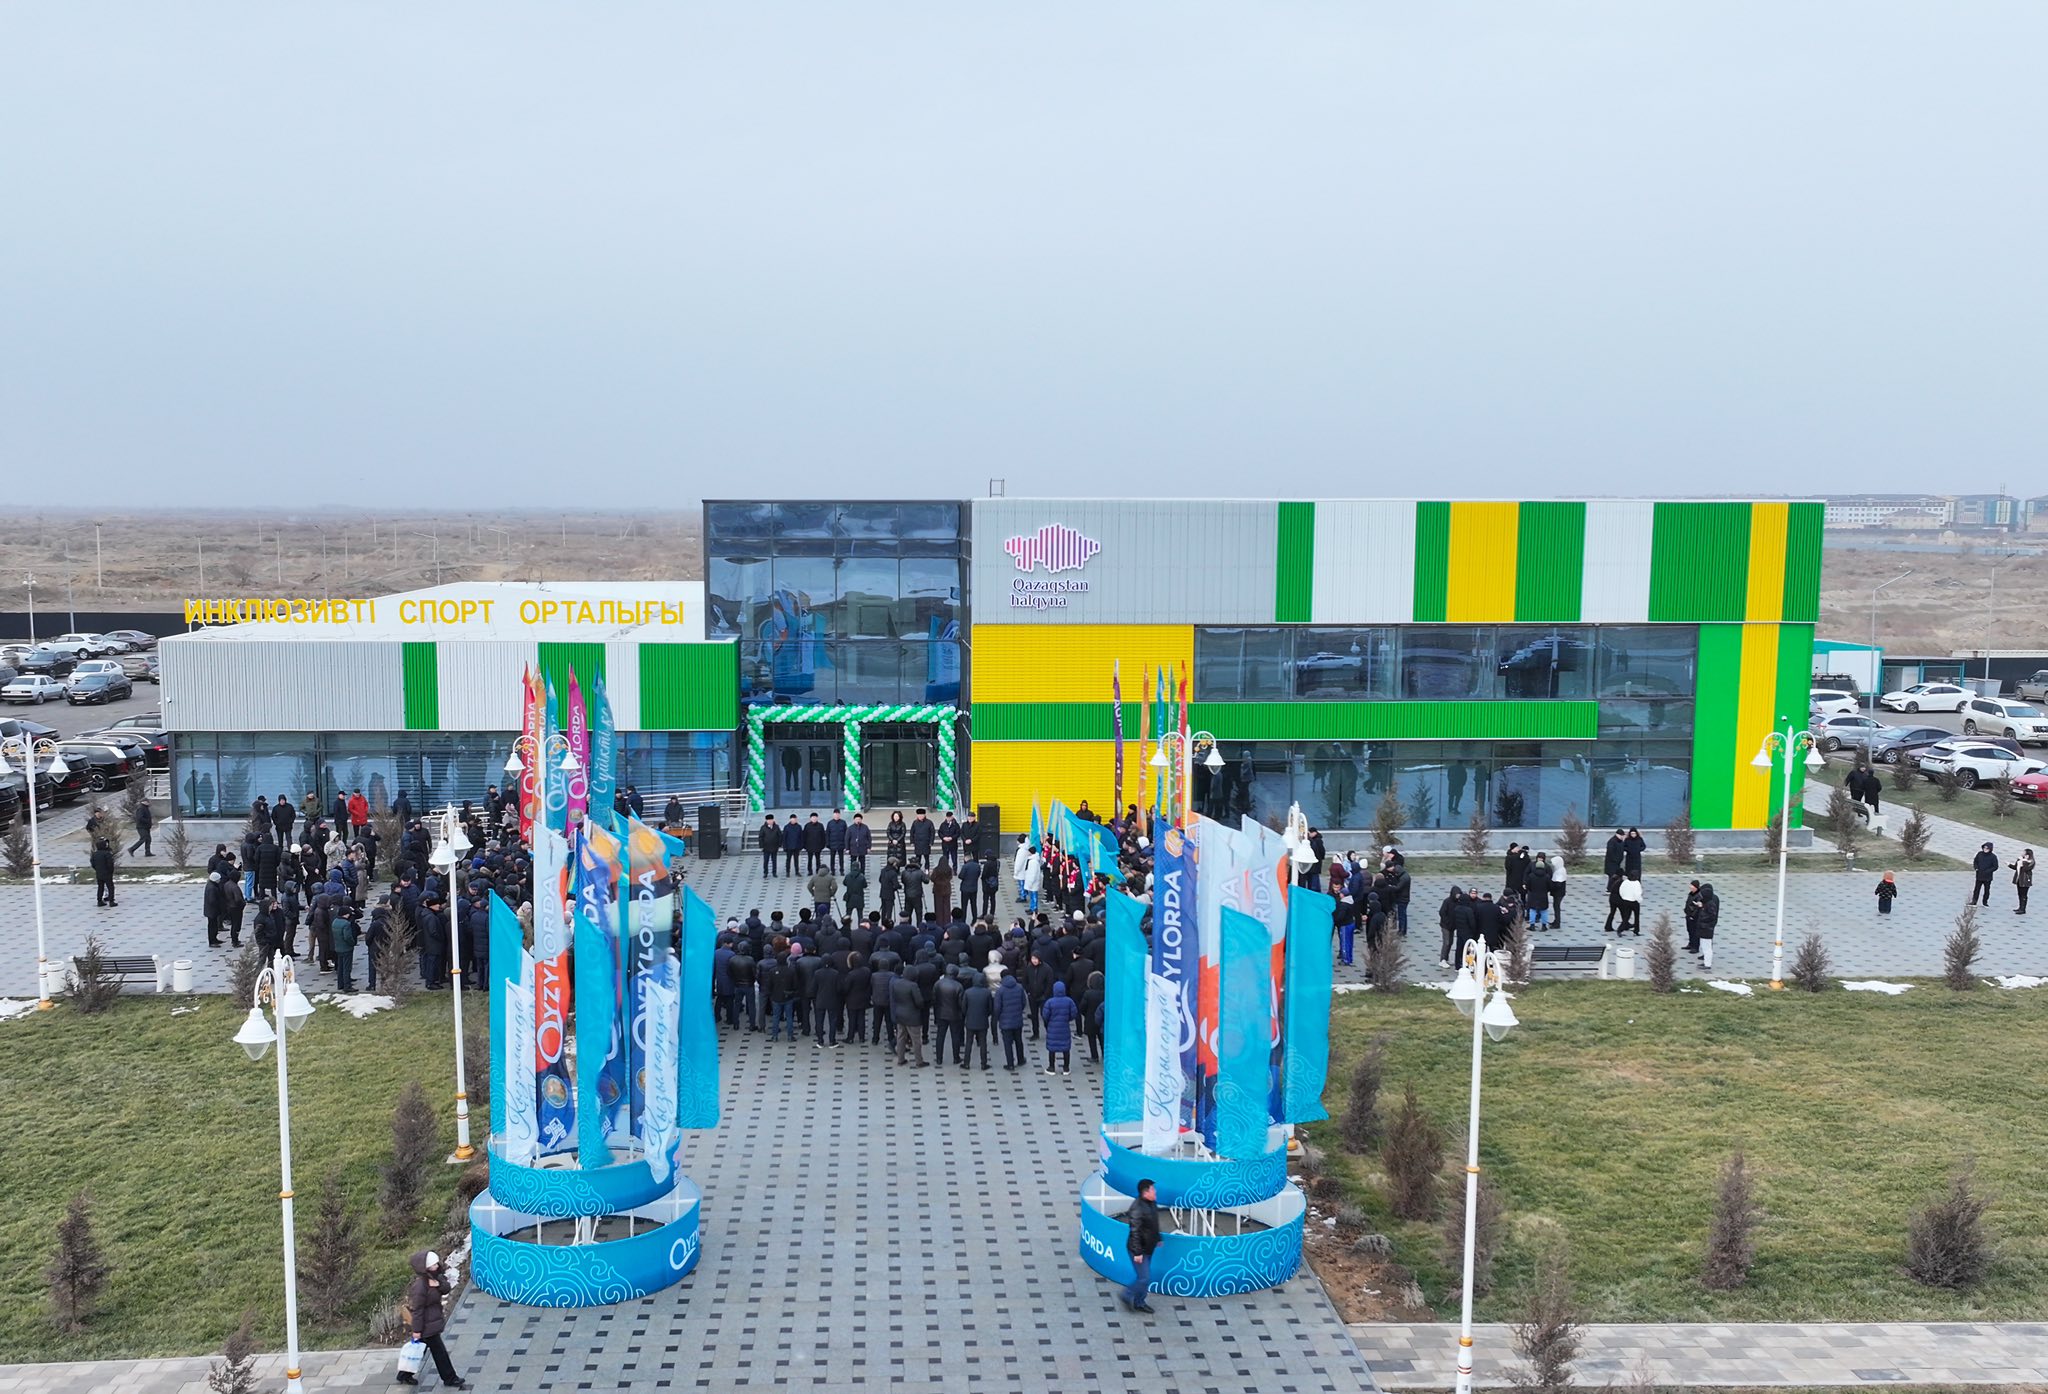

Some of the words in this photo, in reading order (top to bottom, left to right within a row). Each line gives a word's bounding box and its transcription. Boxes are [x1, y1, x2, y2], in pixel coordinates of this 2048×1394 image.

[1012, 578, 1089, 595] Qazaqstan
[184, 598, 376, 625] ИНКЛЮЗИВТІ
[399, 599, 495, 625] СПОРТ
[519, 599, 685, 625] ОРТАЛЫҒЫ
[1010, 593, 1068, 610] halqyna
[536, 875, 564, 1064] QYZYLORDA
